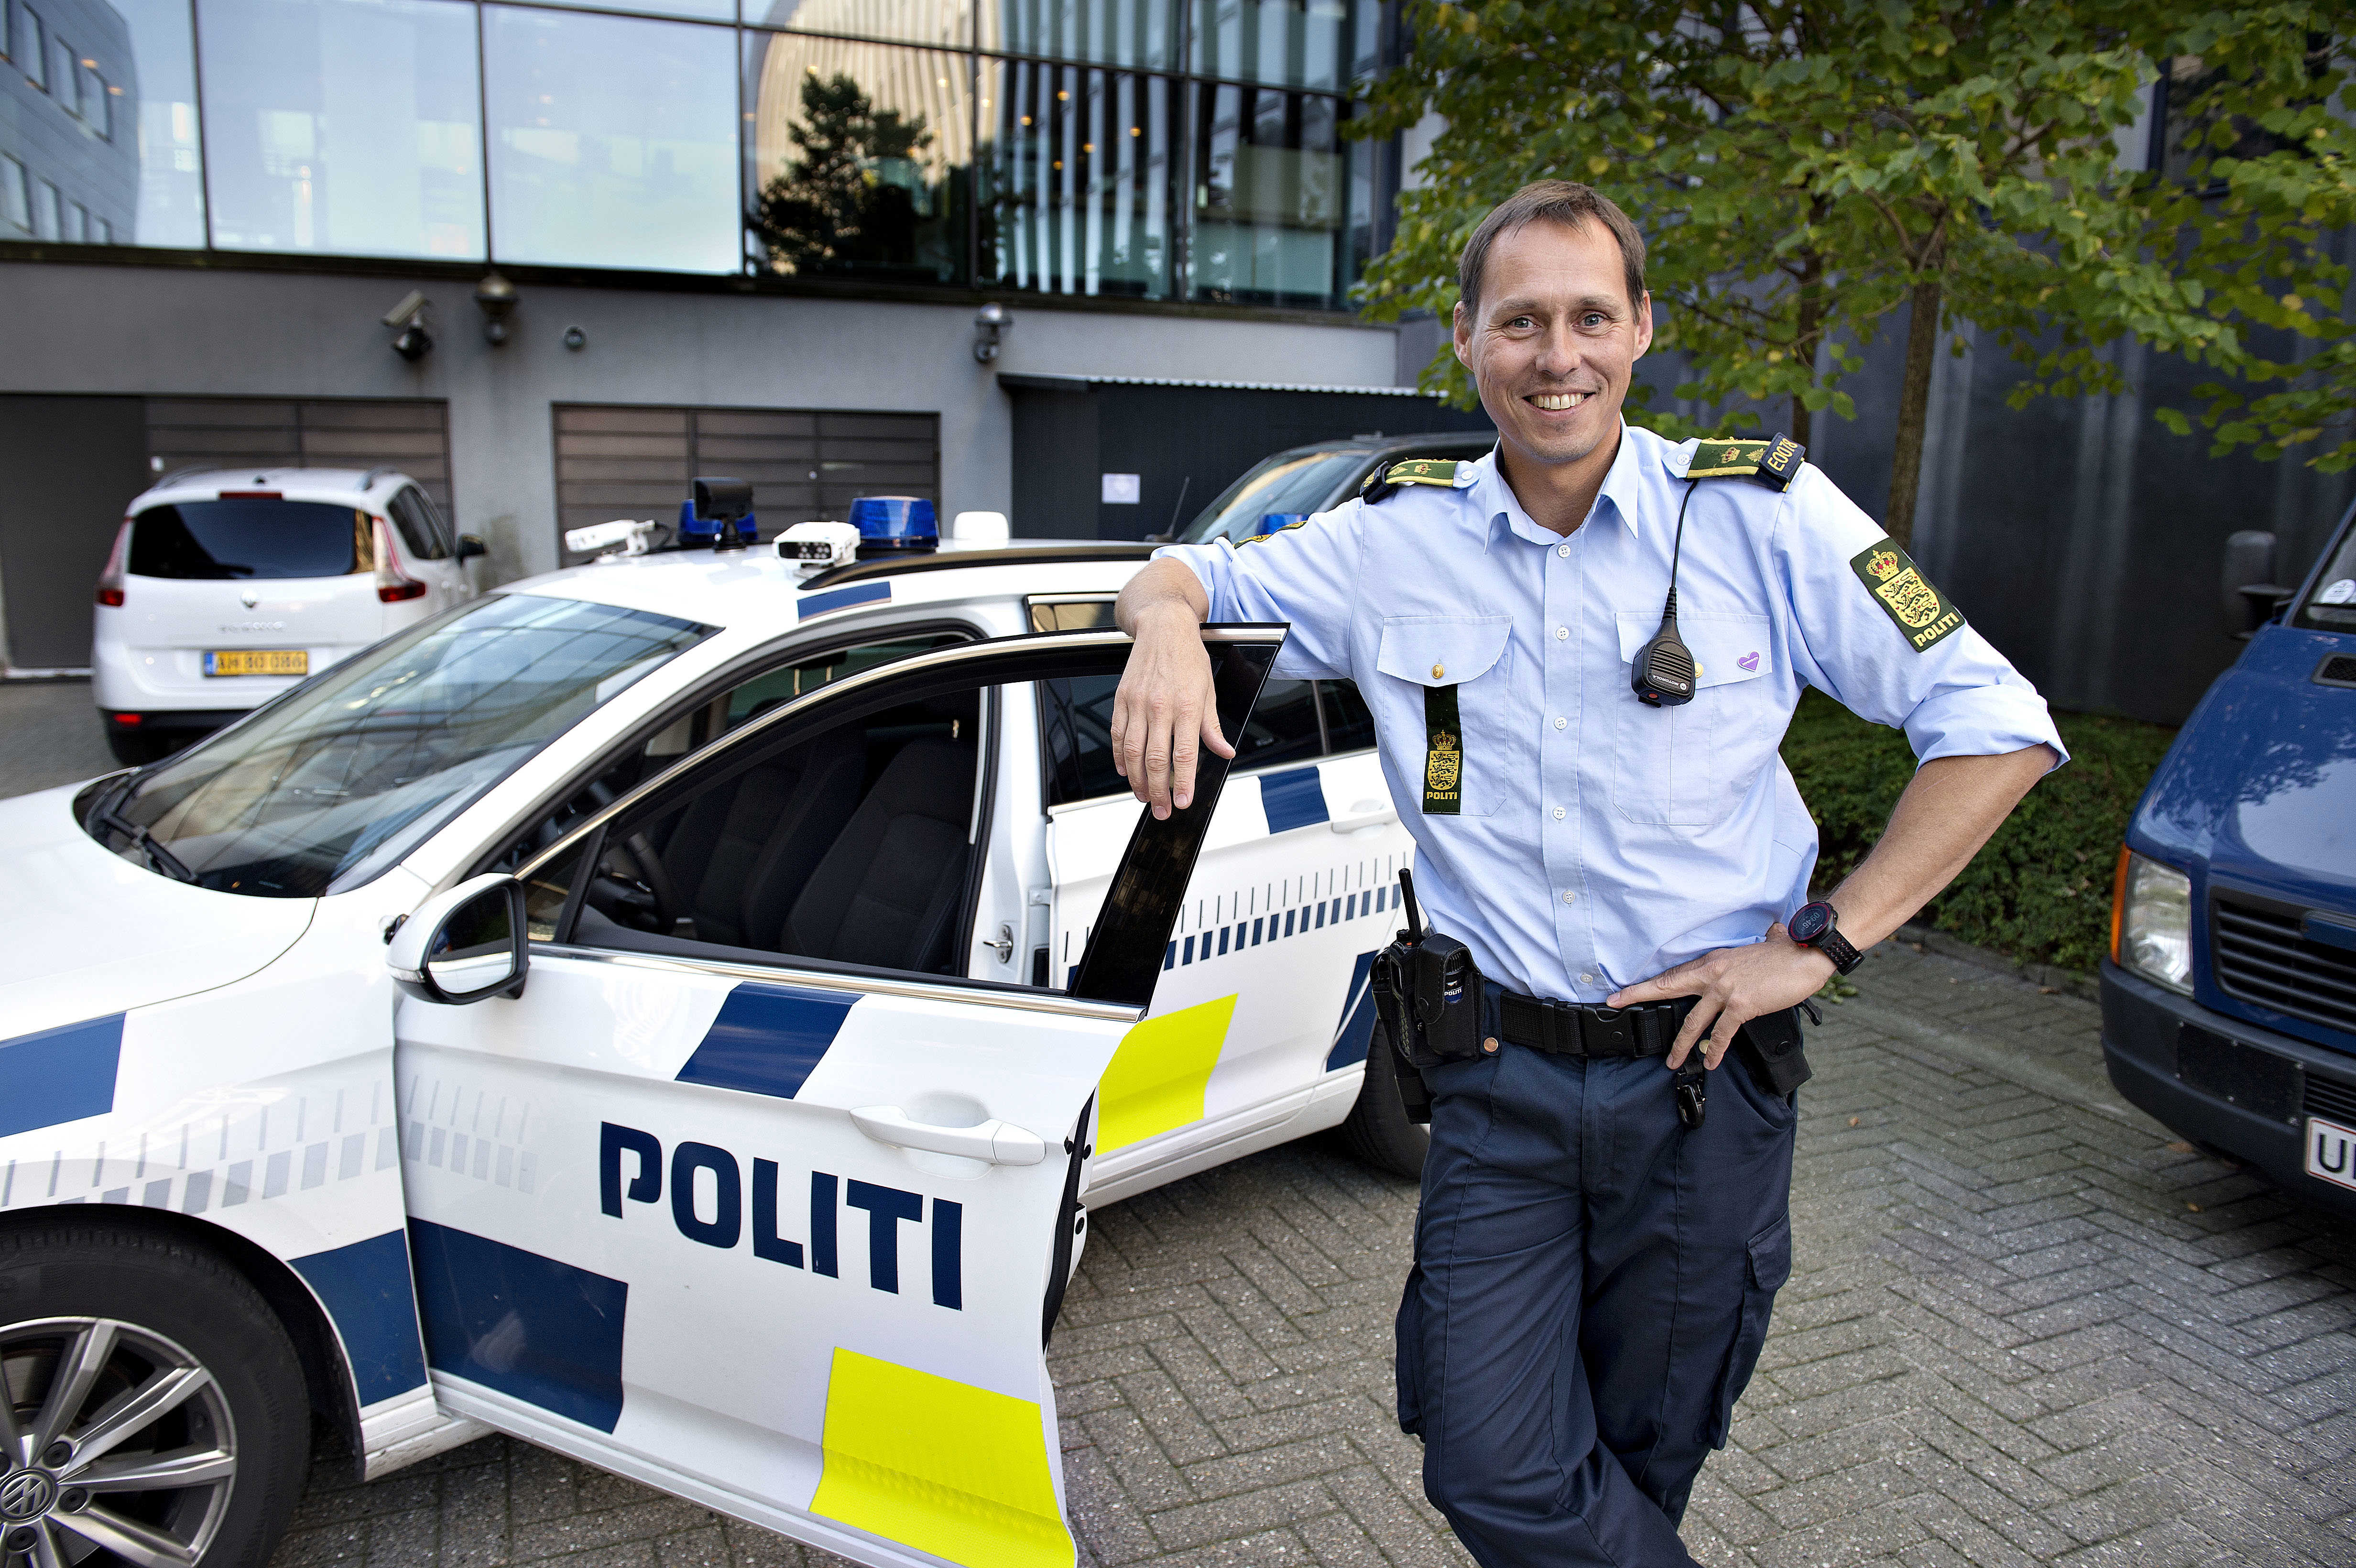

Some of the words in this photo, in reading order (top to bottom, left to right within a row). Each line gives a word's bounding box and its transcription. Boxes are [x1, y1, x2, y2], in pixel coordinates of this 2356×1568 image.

[1767, 437, 1798, 472] E0078
[1913, 611, 1959, 647] POLITI
[1653, 675, 1679, 686] MOTOROLA
[1426, 791, 1458, 800] POLITI
[1444, 988, 1462, 996] POLITI
[2318, 1132, 2356, 1179] U
[600, 1121, 963, 1311] POLITI
